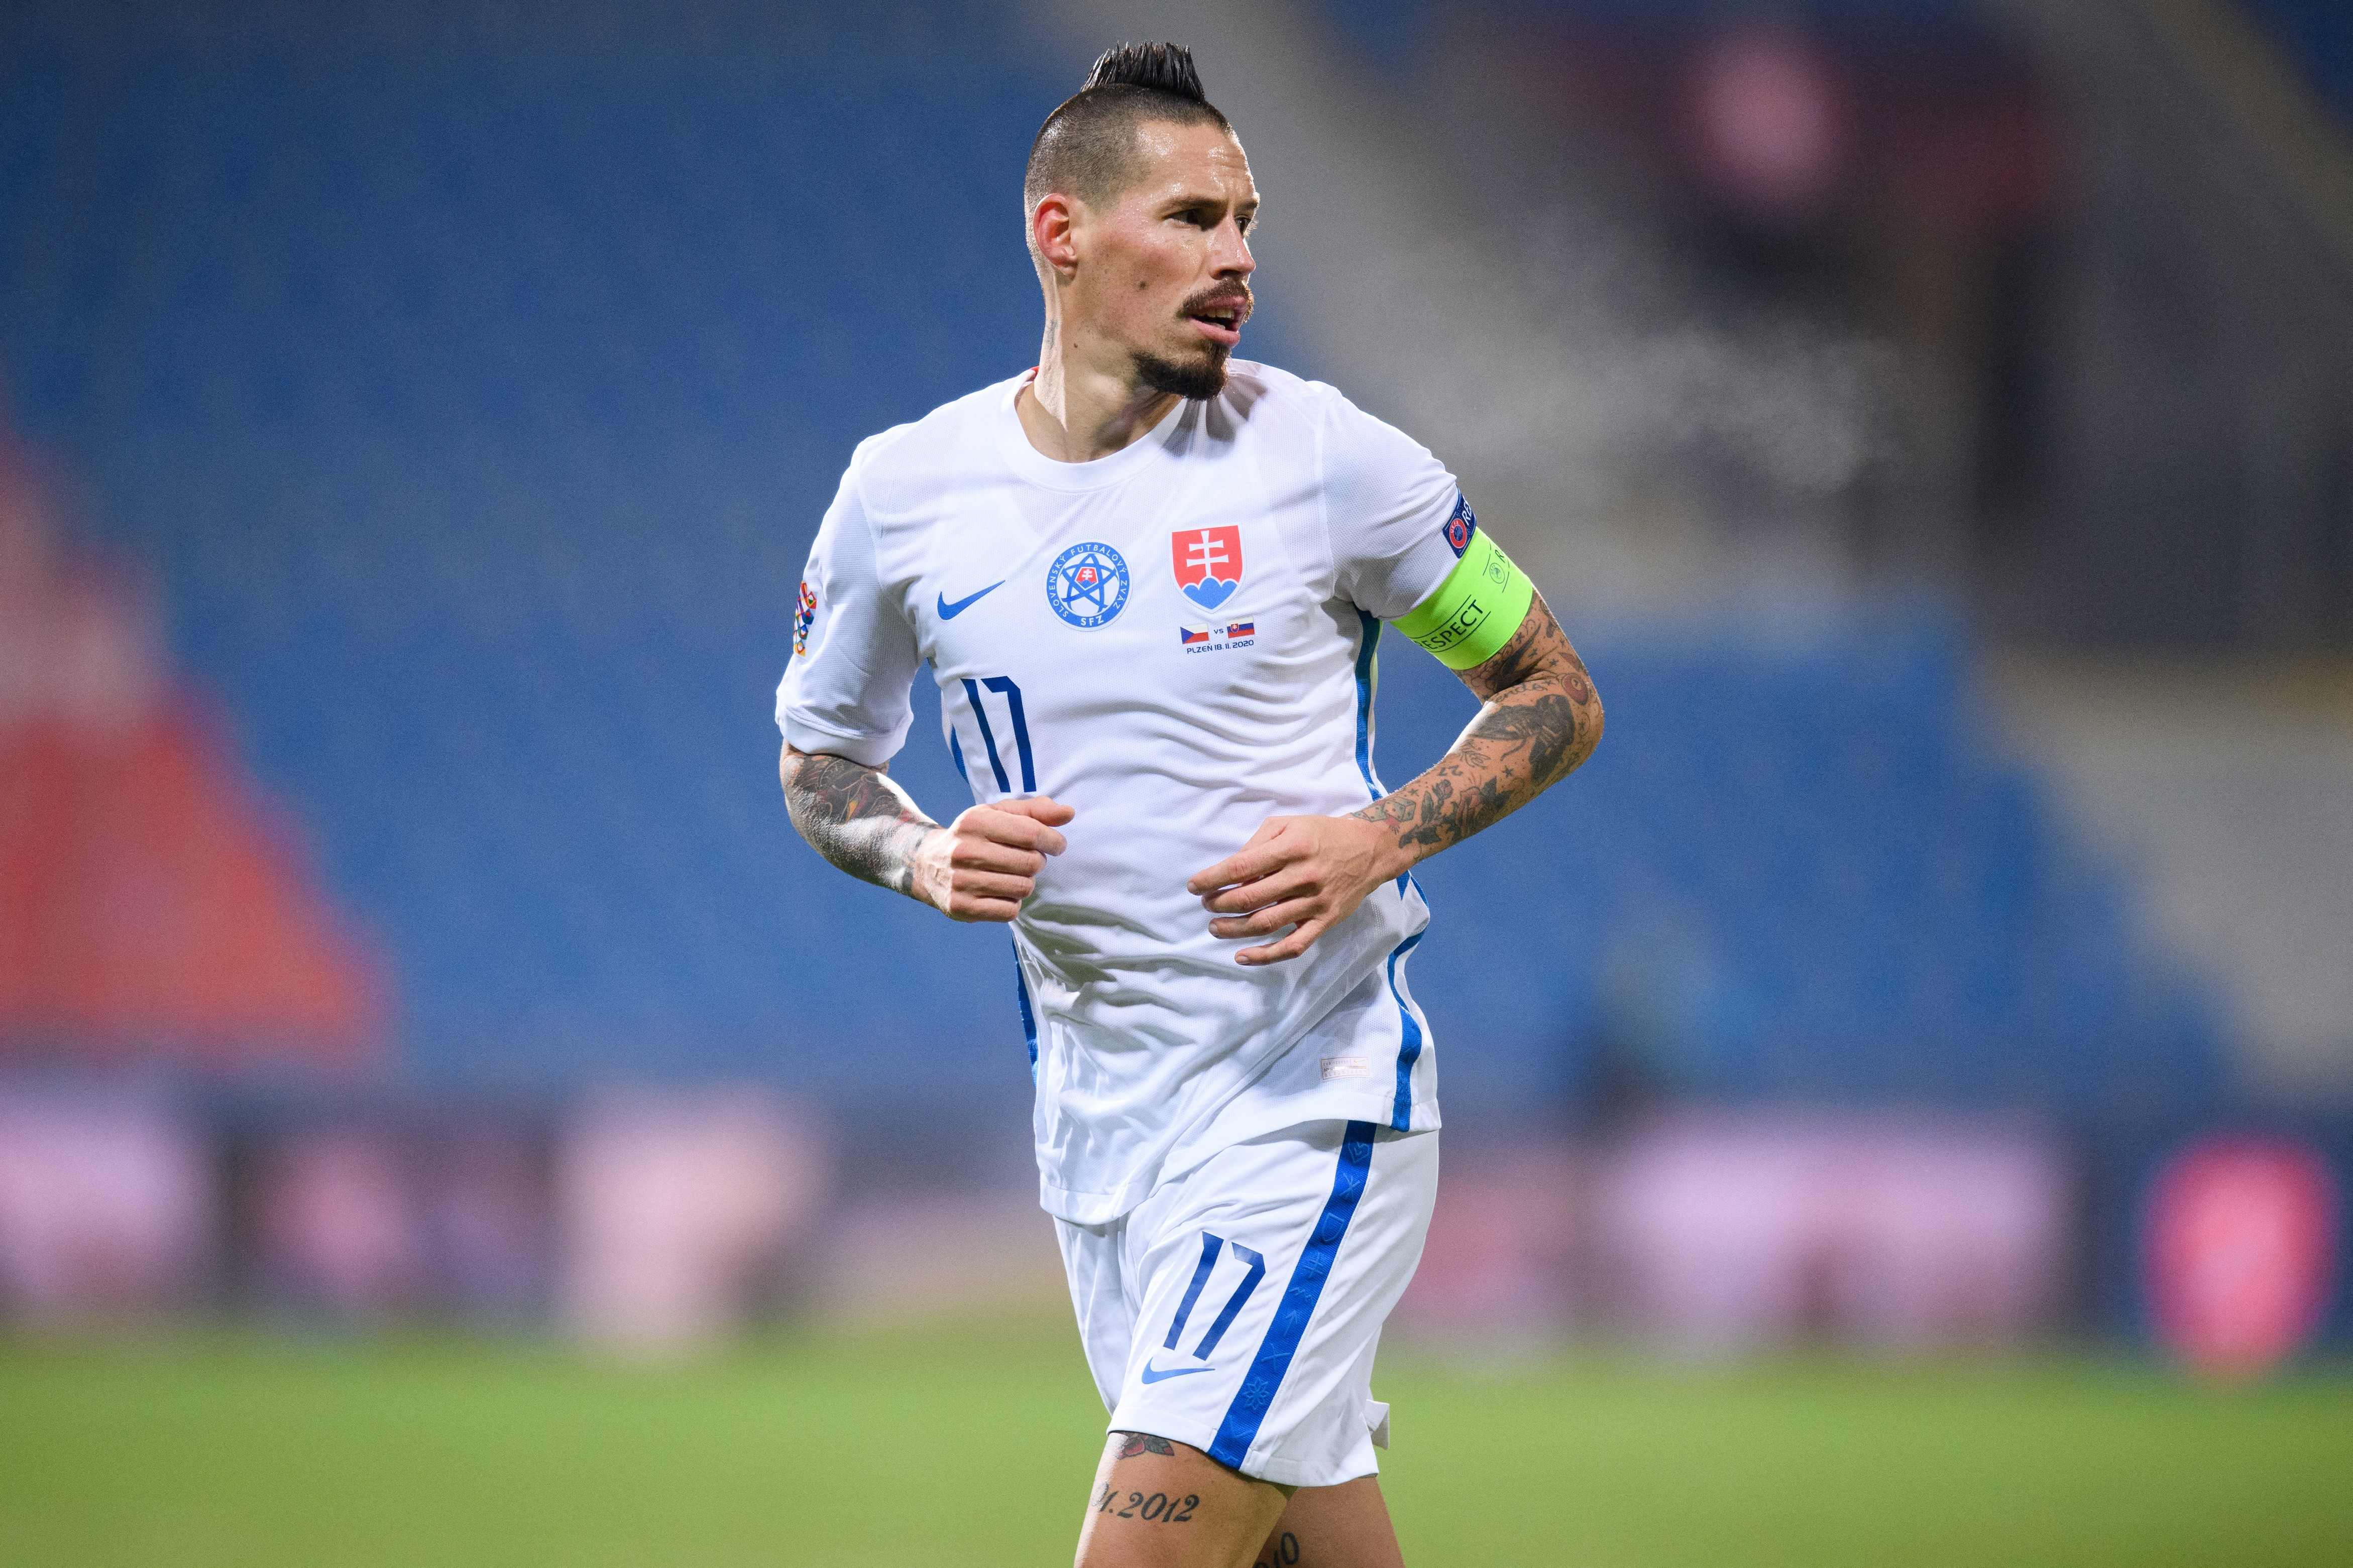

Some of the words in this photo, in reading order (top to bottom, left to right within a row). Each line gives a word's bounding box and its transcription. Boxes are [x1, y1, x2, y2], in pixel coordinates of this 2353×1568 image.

[1049, 555, 1069, 618] SLOVENSKÝ
[1071, 544, 1127, 573] FUTBALOVÝ
[1113, 580, 1128, 610] ZVÄZ
[1080, 615, 1104, 627] SFZ
[1186, 643, 1213, 654] PLZEŇ
[960, 675, 1037, 793] 17
[1163, 1231, 1266, 1361] 17
